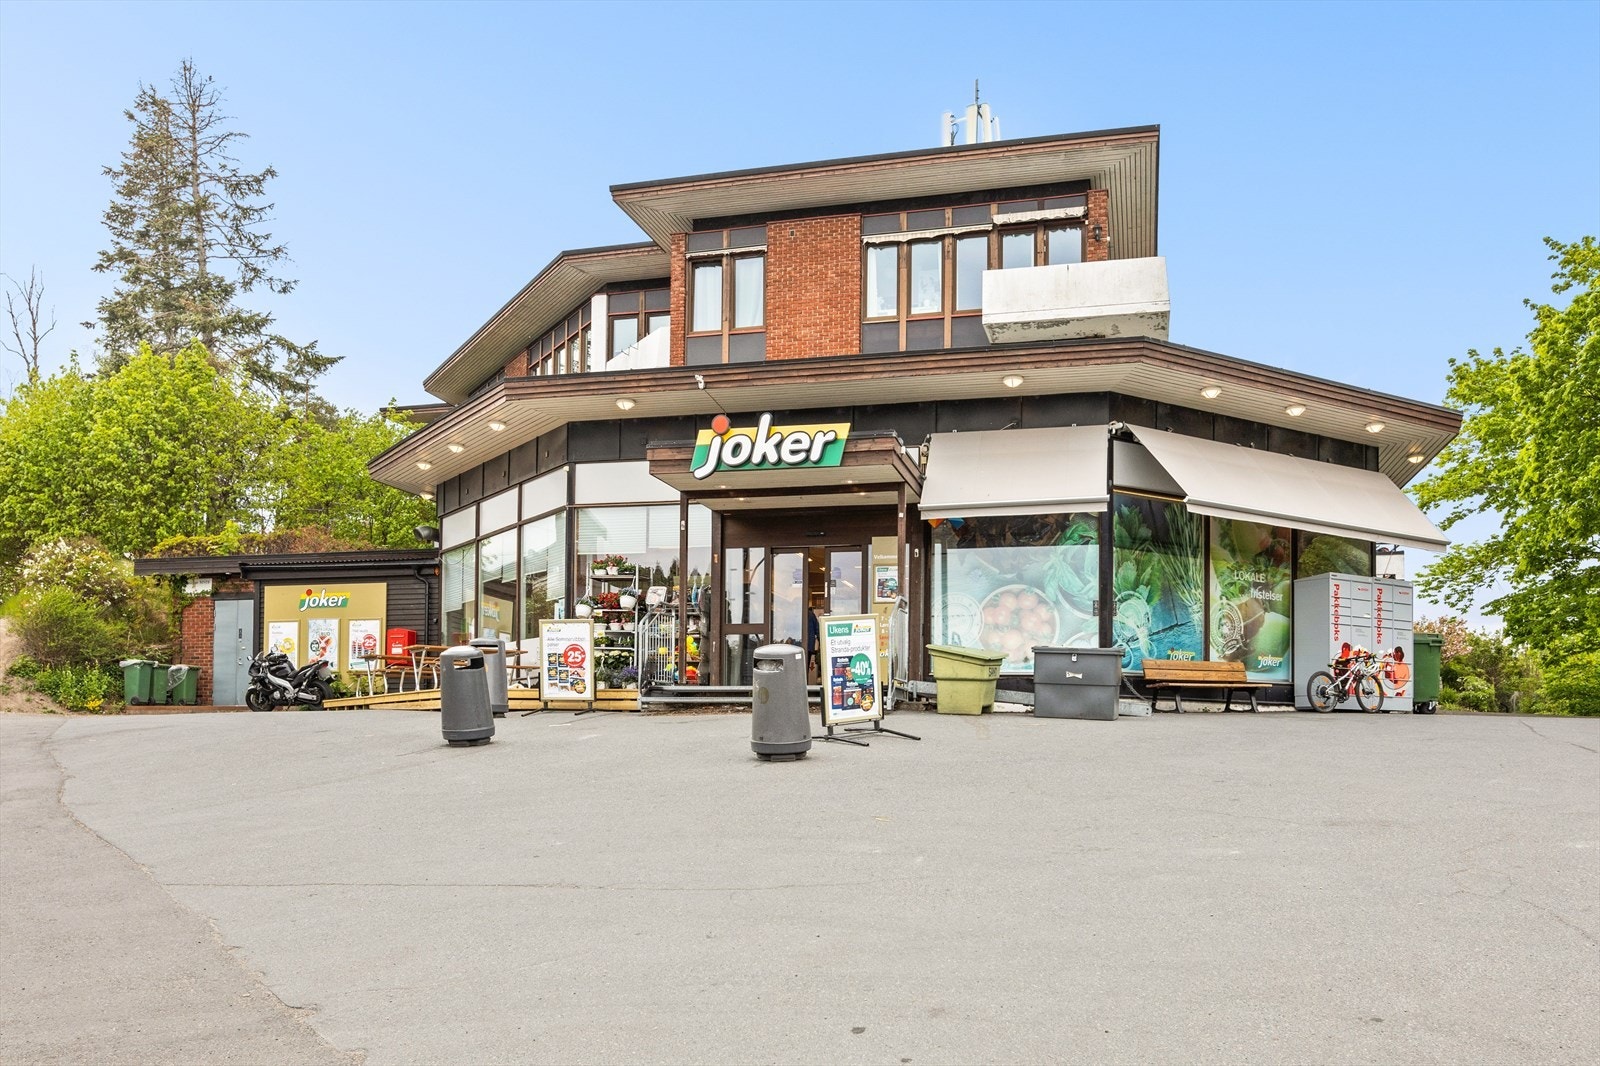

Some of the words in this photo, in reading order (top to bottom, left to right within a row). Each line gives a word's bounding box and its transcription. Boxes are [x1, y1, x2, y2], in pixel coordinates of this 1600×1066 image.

[693, 412, 836, 480] joker
[1234, 569, 1266, 583] LOKALE
[299, 588, 347, 612] joker
[829, 625, 850, 634] Ukens
[1169, 647, 1193, 660] joker
[1257, 653, 1281, 669] joker
